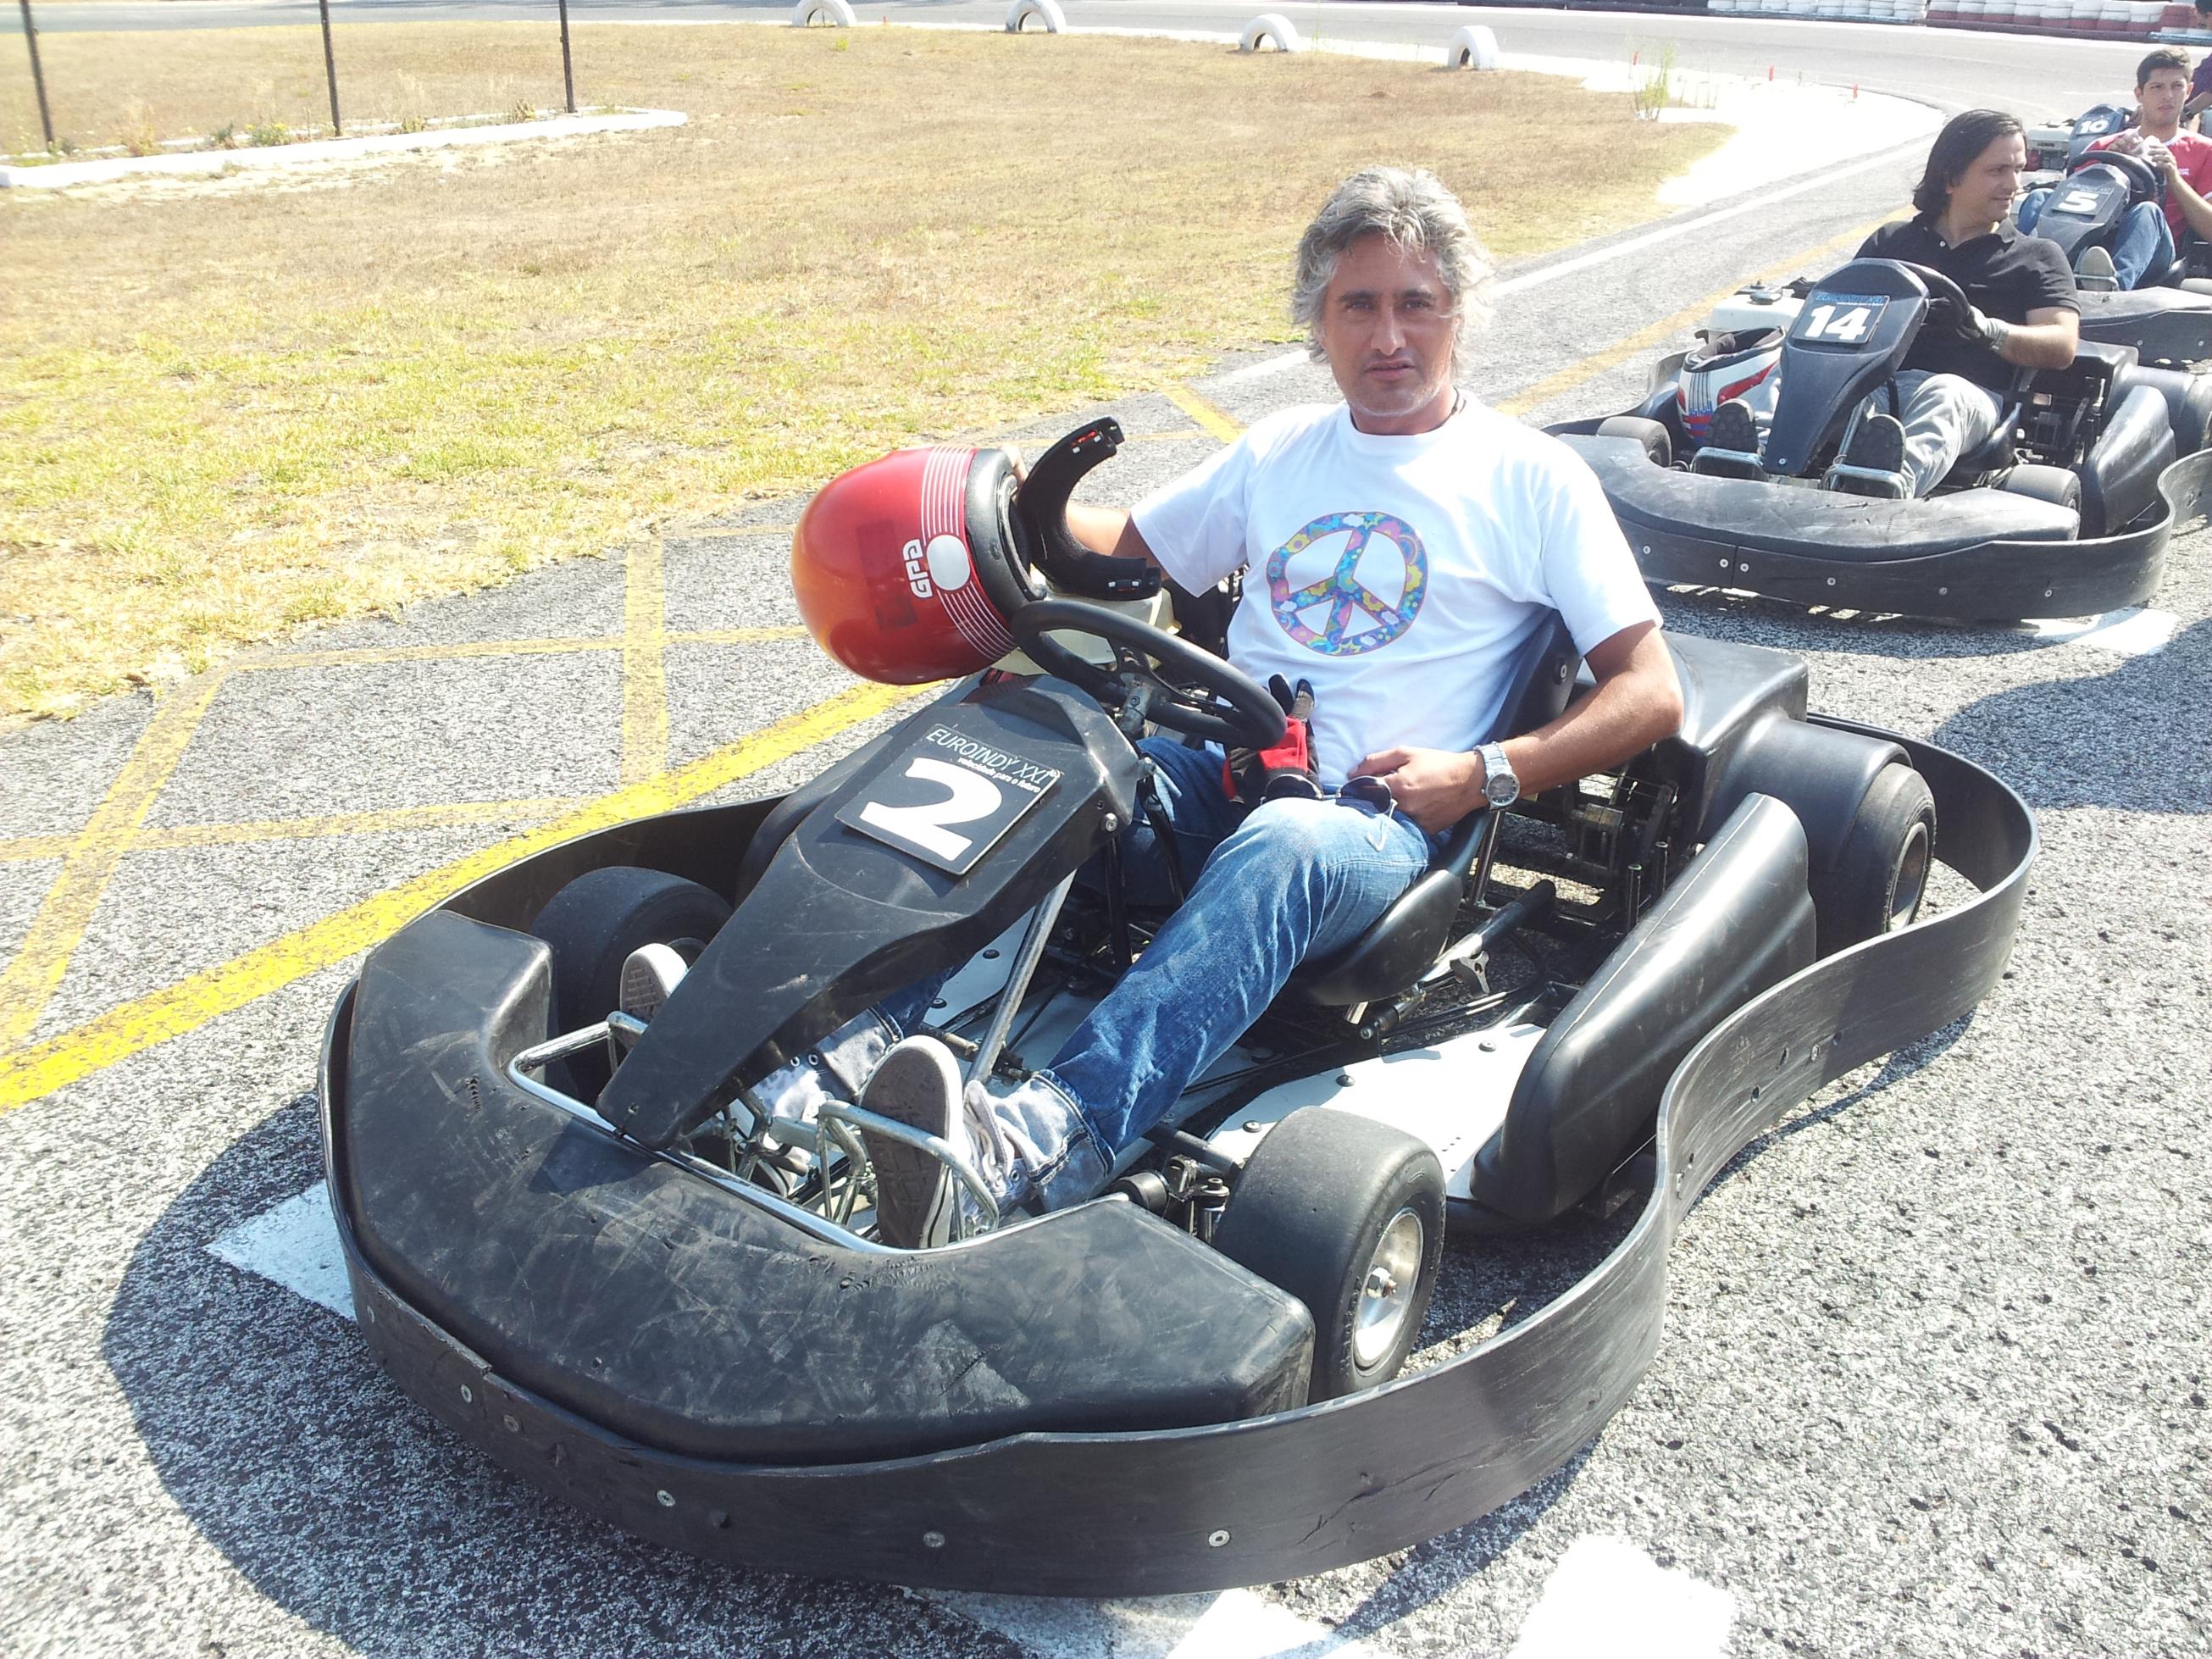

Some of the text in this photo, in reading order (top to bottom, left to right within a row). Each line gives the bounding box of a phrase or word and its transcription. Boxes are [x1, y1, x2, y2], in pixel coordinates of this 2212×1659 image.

[2080, 120, 2109, 134] 10
[2059, 190, 2099, 212] 5
[1805, 305, 1871, 341] 14
[926, 728, 1051, 784] EUROINDY XXI
[859, 757, 1003, 861] 2
